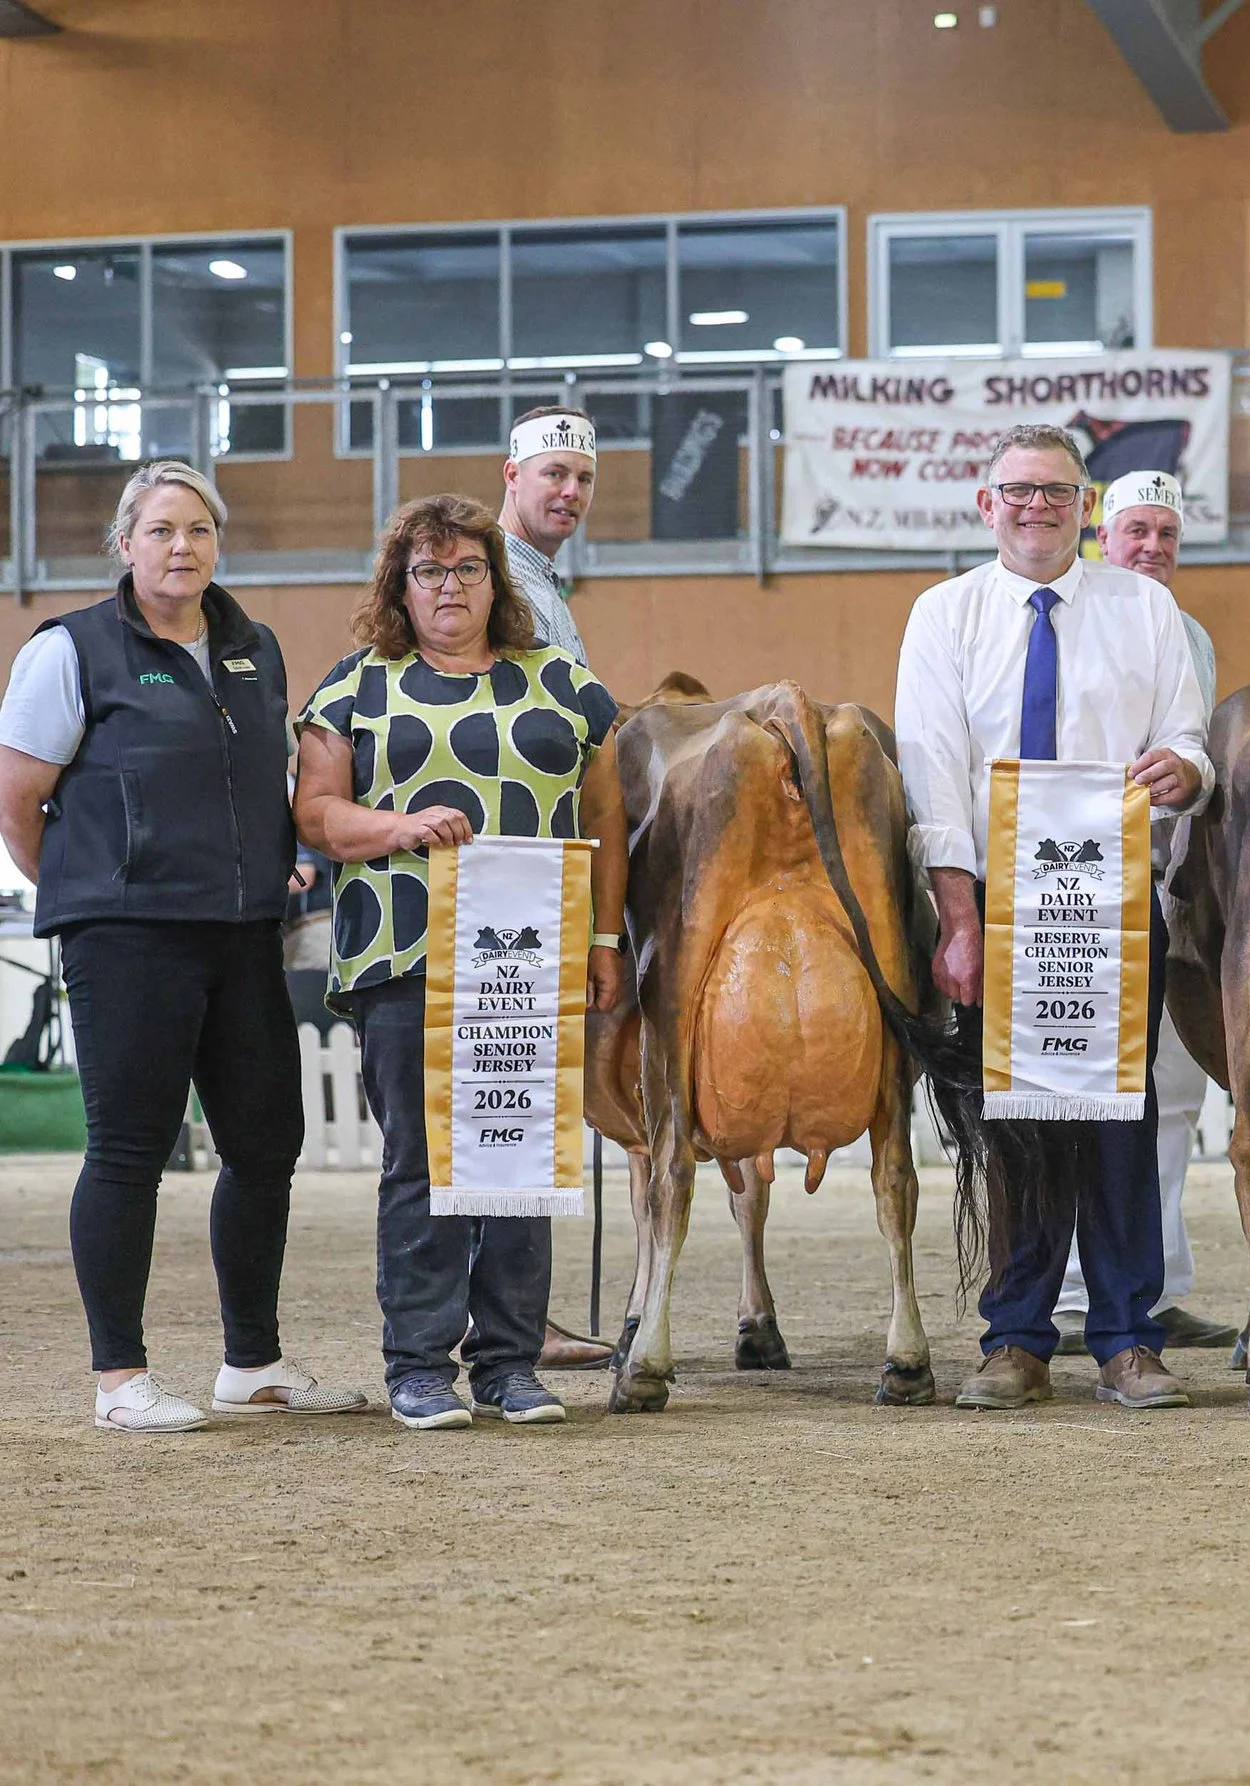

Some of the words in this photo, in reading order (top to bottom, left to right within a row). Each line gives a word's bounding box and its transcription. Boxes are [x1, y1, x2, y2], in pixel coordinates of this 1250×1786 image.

[810, 374, 954, 404] MILKING
[985, 367, 1209, 404] SHORTHORNS
[542, 432, 586, 450] SEMEX
[832, 426, 940, 452] BECAUSE
[851, 458, 908, 480] NOW
[1138, 487, 1177, 507] SEMEX
[140, 673, 175, 684] FMG
[1057, 878, 1080, 891] NZ
[1041, 893, 1096, 906] DAIRY
[1038, 909, 1098, 922] EVENT
[502, 932, 513, 940] NZ
[1034, 932, 1100, 945] RESERVE
[1024, 947, 1109, 959] CHAMPION
[496, 965, 519, 979] NZ
[1038, 961, 1094, 973] SENIOR
[480, 981, 535, 995] DAIRY
[1038, 976, 1093, 988] JERSEY
[478, 997, 536, 1011] EVENT
[1036, 1000, 1096, 1020] 2026
[458, 1025, 553, 1040] CHAMPION
[474, 1043, 536, 1056] SENIOR
[1042, 1037, 1088, 1051] FMG
[473, 1059, 535, 1073] JERSEY
[474, 1089, 532, 1110] 2026
[480, 1128, 524, 1143] FMG
